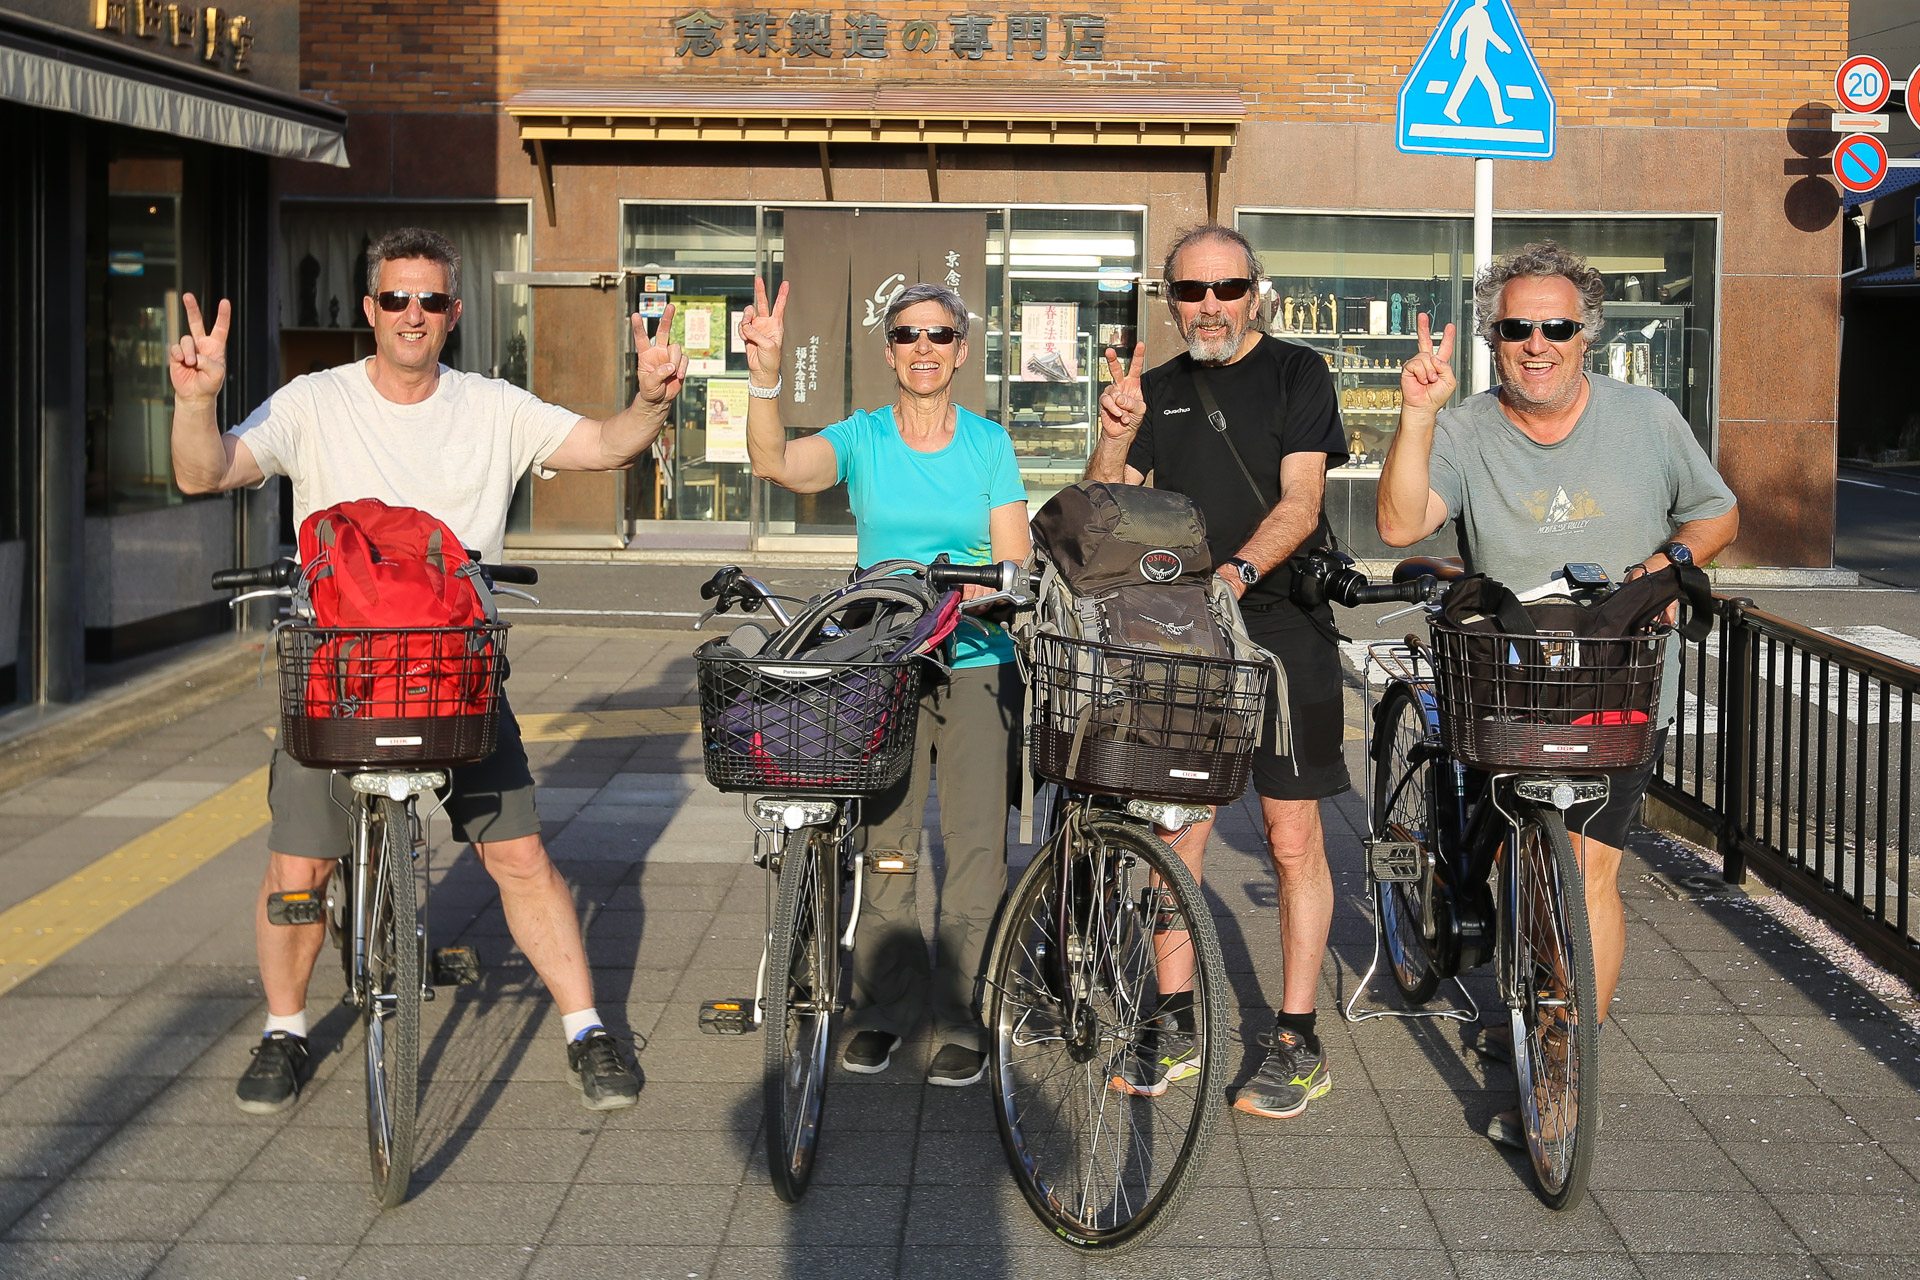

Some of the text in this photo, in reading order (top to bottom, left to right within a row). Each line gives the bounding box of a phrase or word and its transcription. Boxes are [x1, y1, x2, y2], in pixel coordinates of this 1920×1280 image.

[674, 10, 1105, 60] 念珠製造の専門店
[1848, 72, 1878, 97] 20
[944, 249, 963, 297] 京念
[687, 333, 707, 341] JOY
[1043, 305, 1057, 354] 春の法要
[1146, 554, 1178, 566] OSPREY
